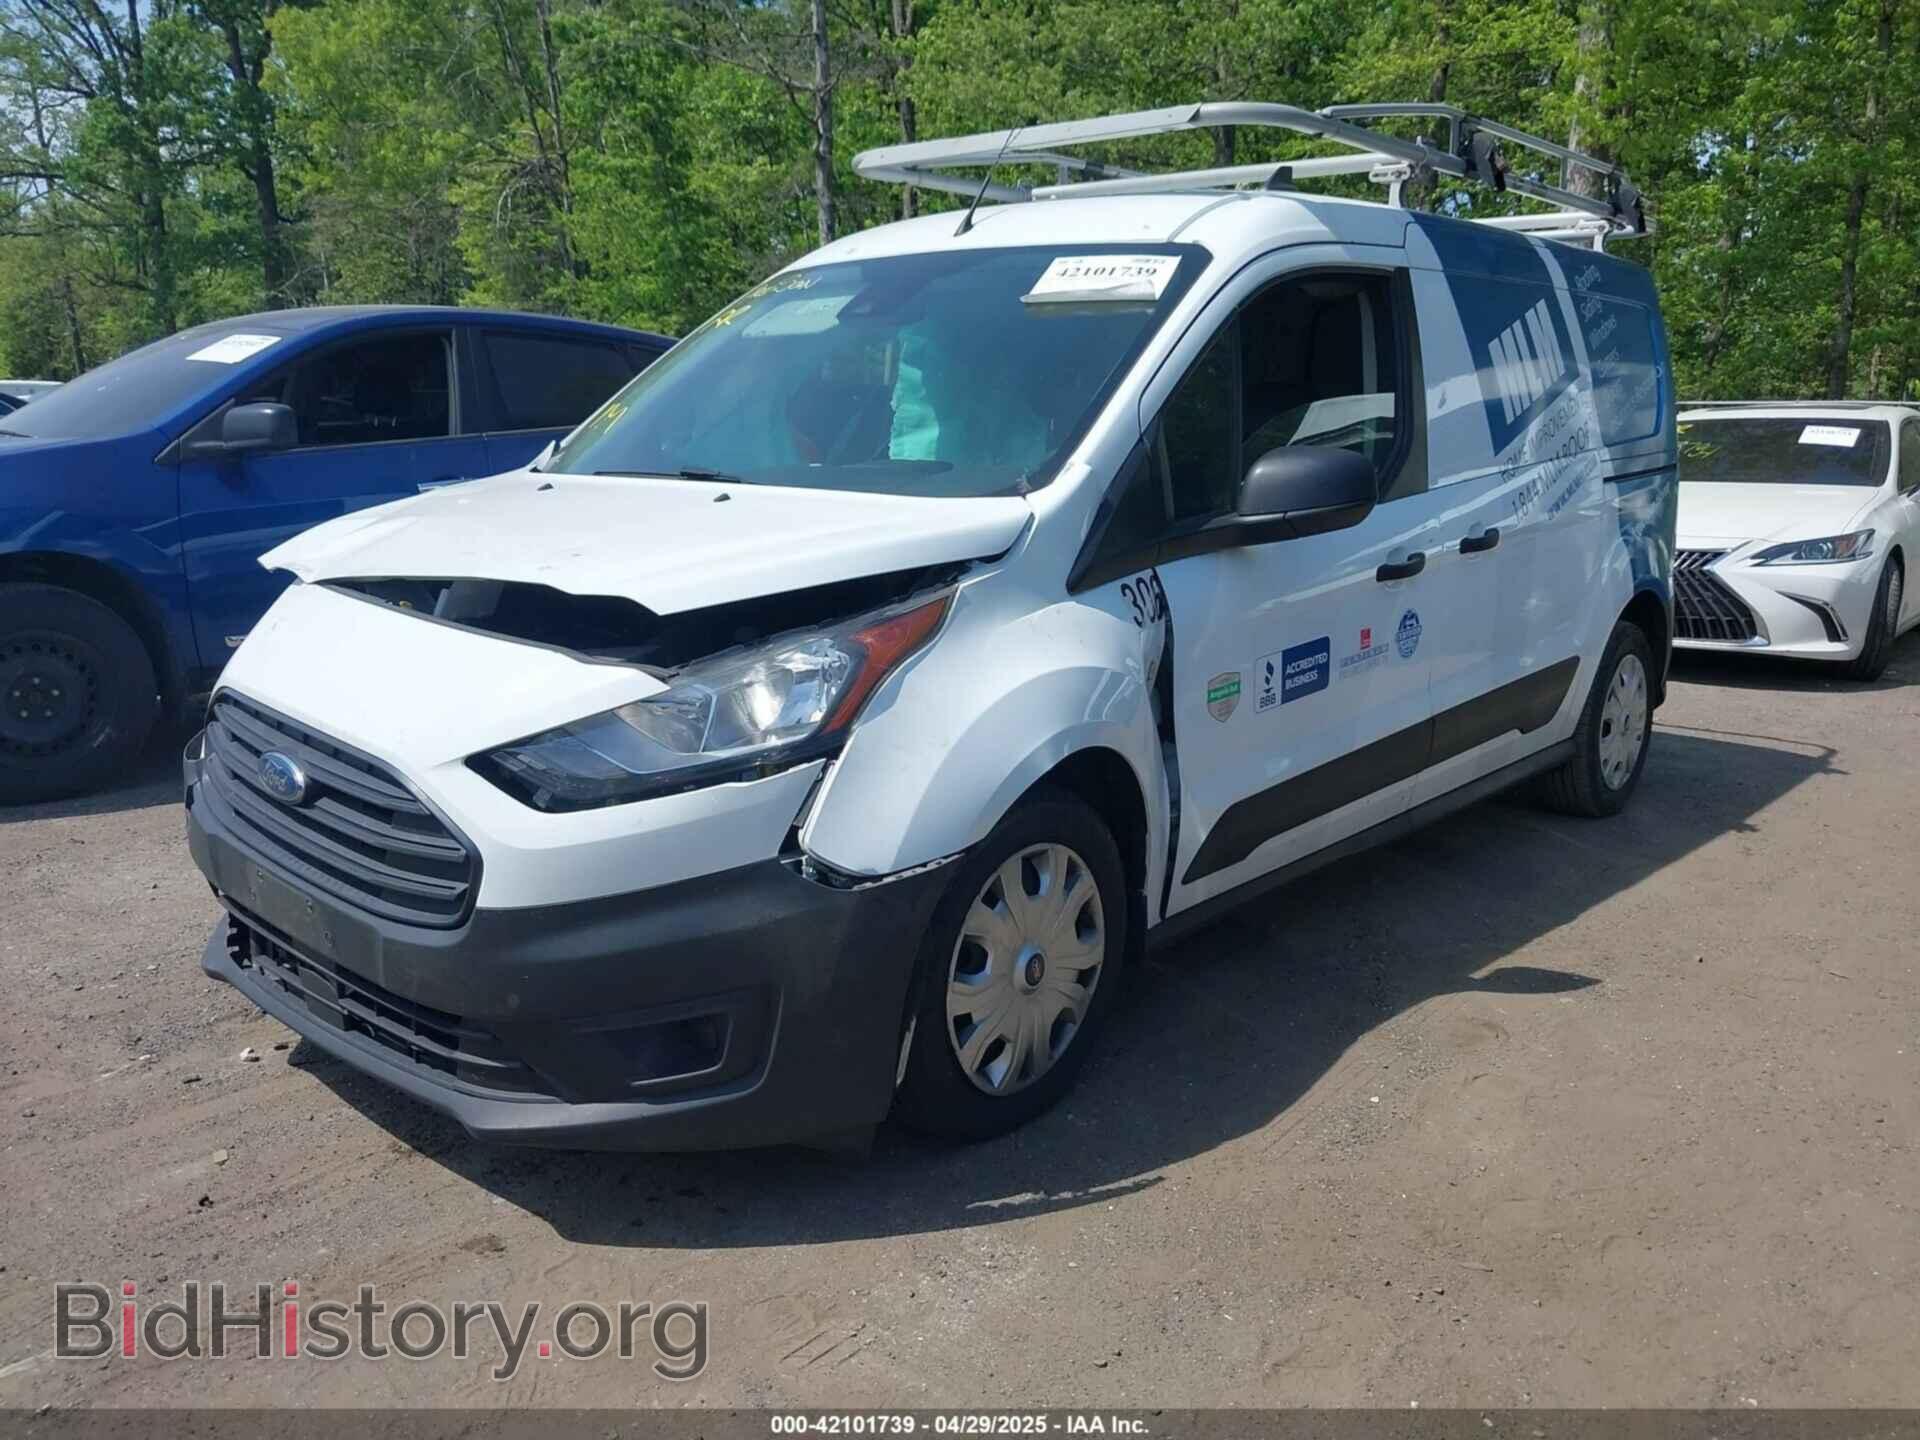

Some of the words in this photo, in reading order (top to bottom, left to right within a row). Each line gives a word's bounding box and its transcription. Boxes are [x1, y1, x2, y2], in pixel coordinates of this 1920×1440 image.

[1056, 265, 1158, 278] 42101739
[1285, 653, 1329, 674] ACCREDITED
[1285, 670, 1319, 690] BUSINESS
[1259, 693, 1277, 708] BBB
[263, 760, 289, 791] Ford
